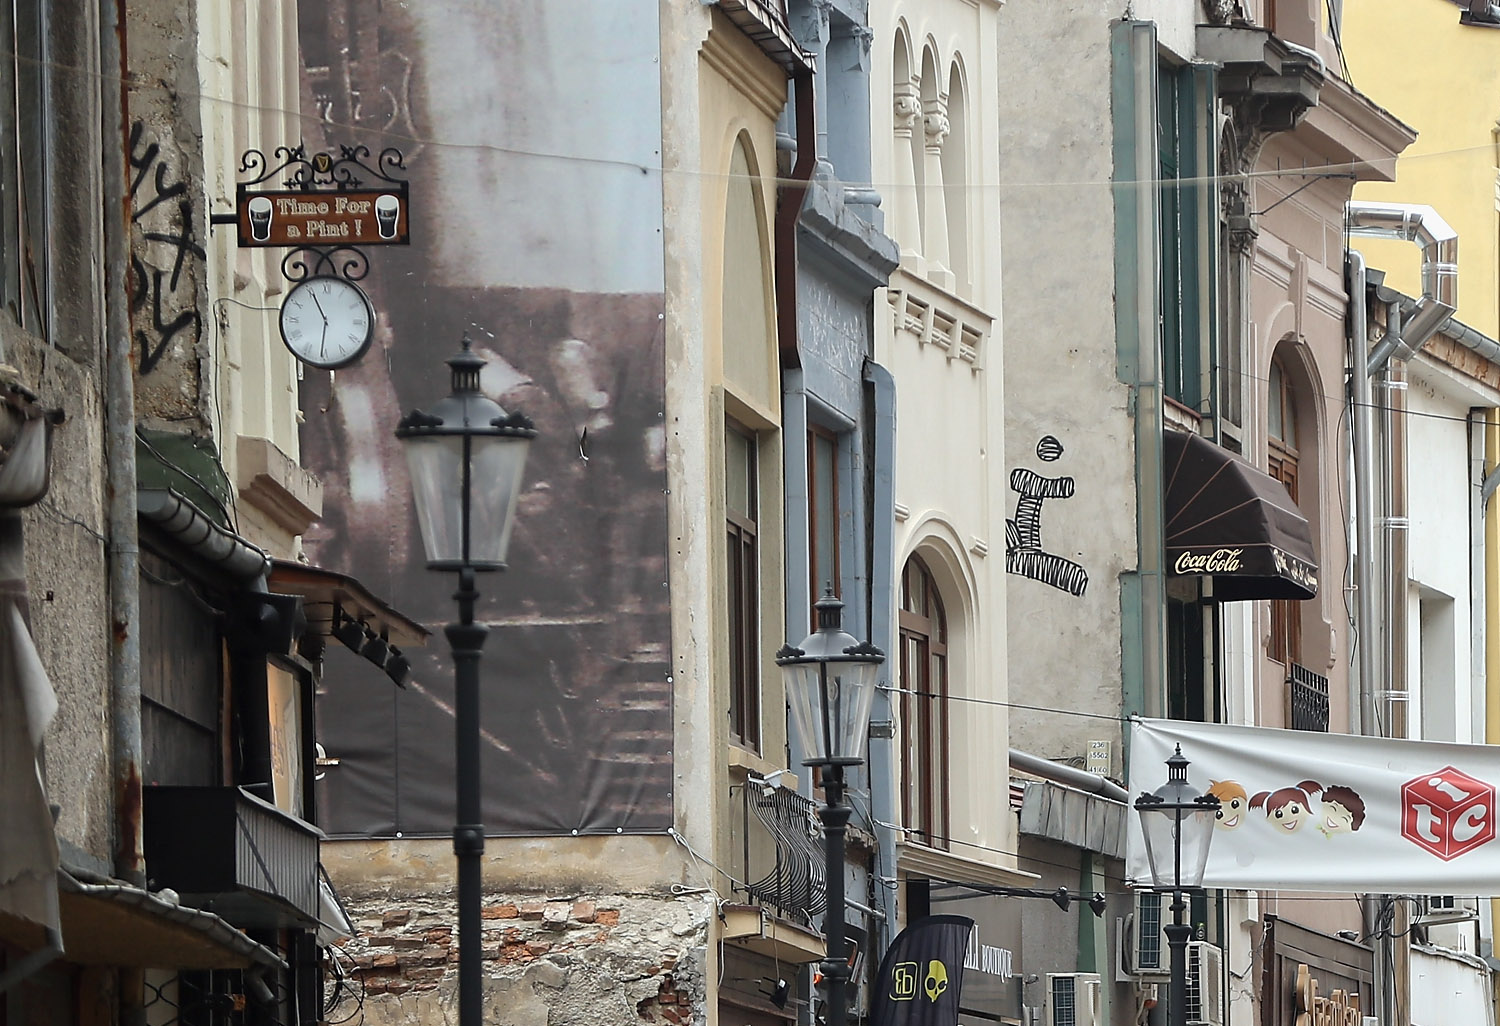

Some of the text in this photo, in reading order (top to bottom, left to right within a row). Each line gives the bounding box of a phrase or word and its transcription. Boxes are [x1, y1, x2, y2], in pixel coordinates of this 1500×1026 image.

[277, 197, 371, 215] Time For
[287, 225, 300, 237] a
[306, 220, 349, 237] Pint
[1175, 549, 1243, 574] Coca-Cola
